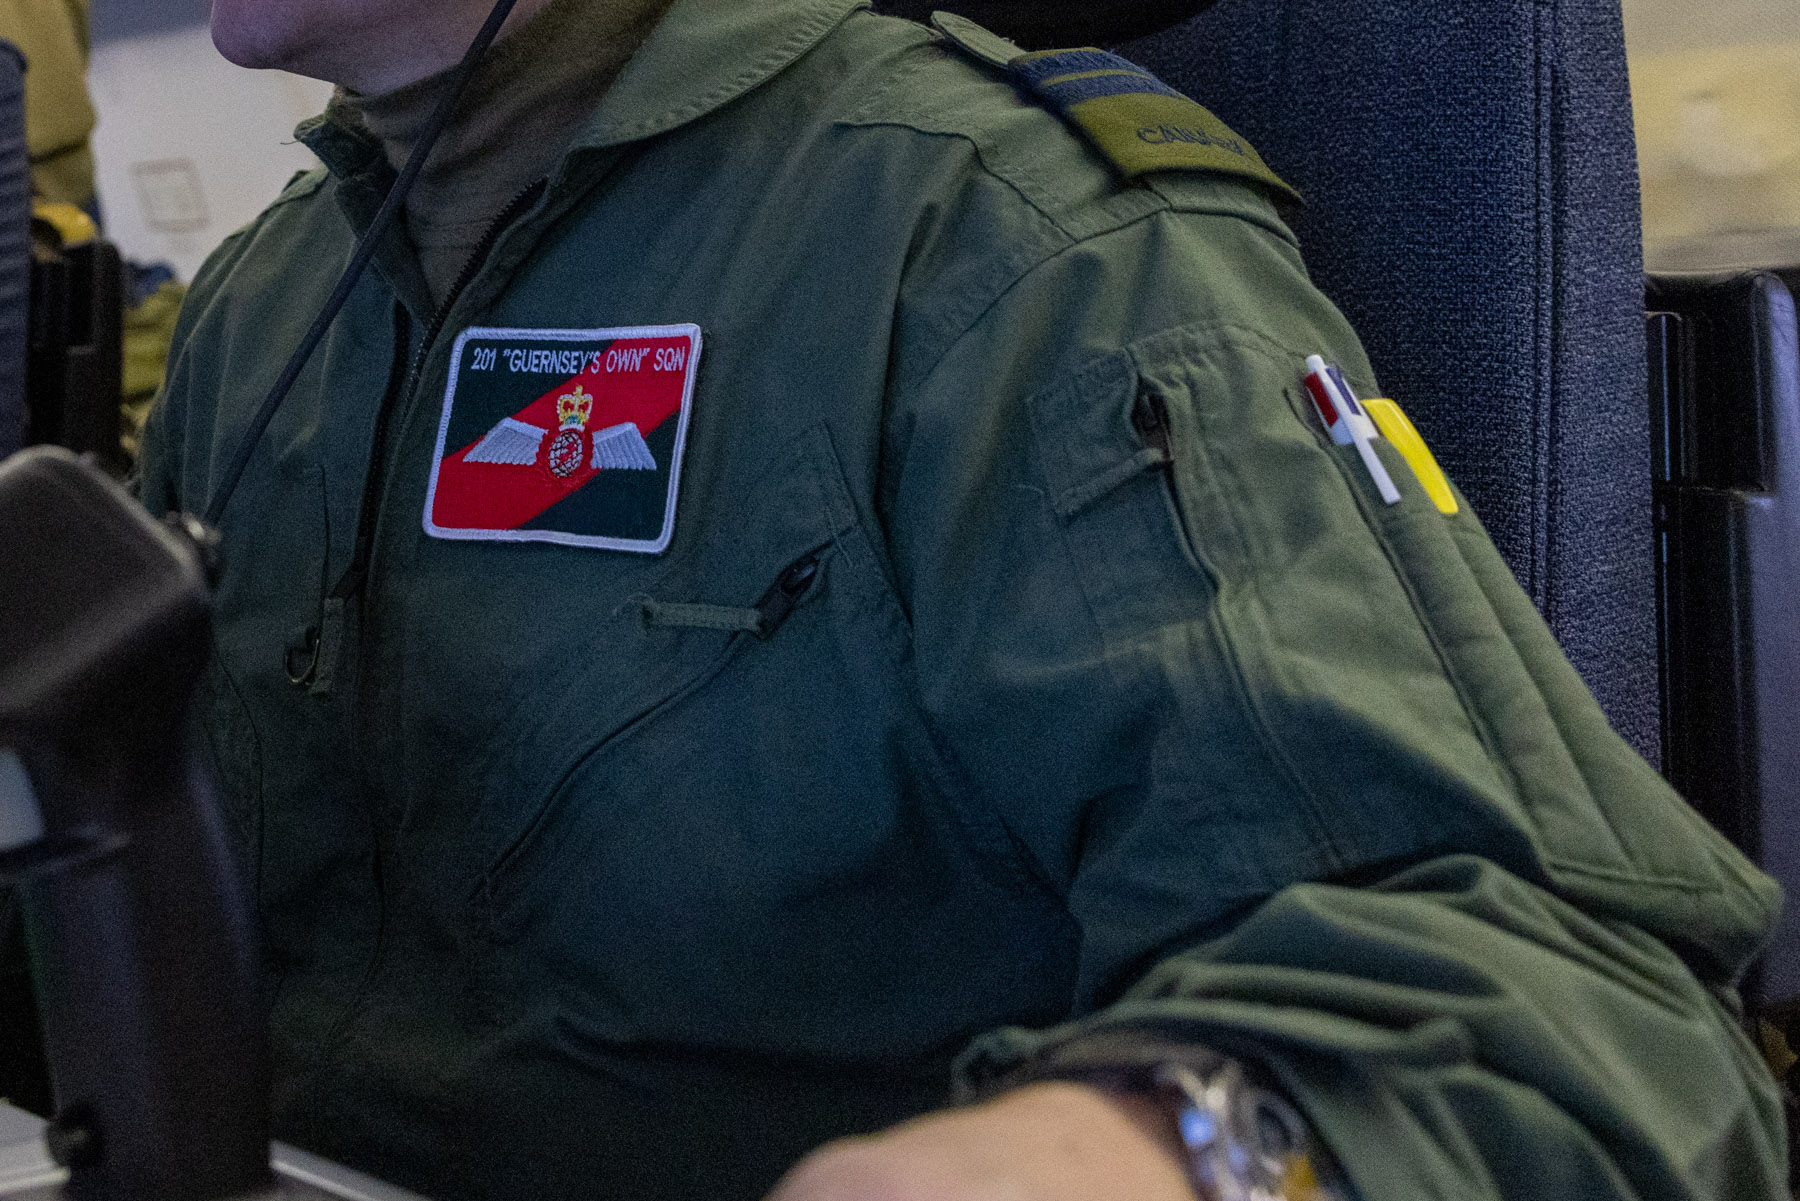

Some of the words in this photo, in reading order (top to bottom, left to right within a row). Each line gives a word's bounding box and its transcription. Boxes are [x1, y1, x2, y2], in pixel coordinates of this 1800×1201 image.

[470, 347, 497, 371] 201
[502, 349, 600, 375] "GUERNSEY'S
[605, 347, 650, 373] OWN"
[653, 345, 686, 372] SQN
